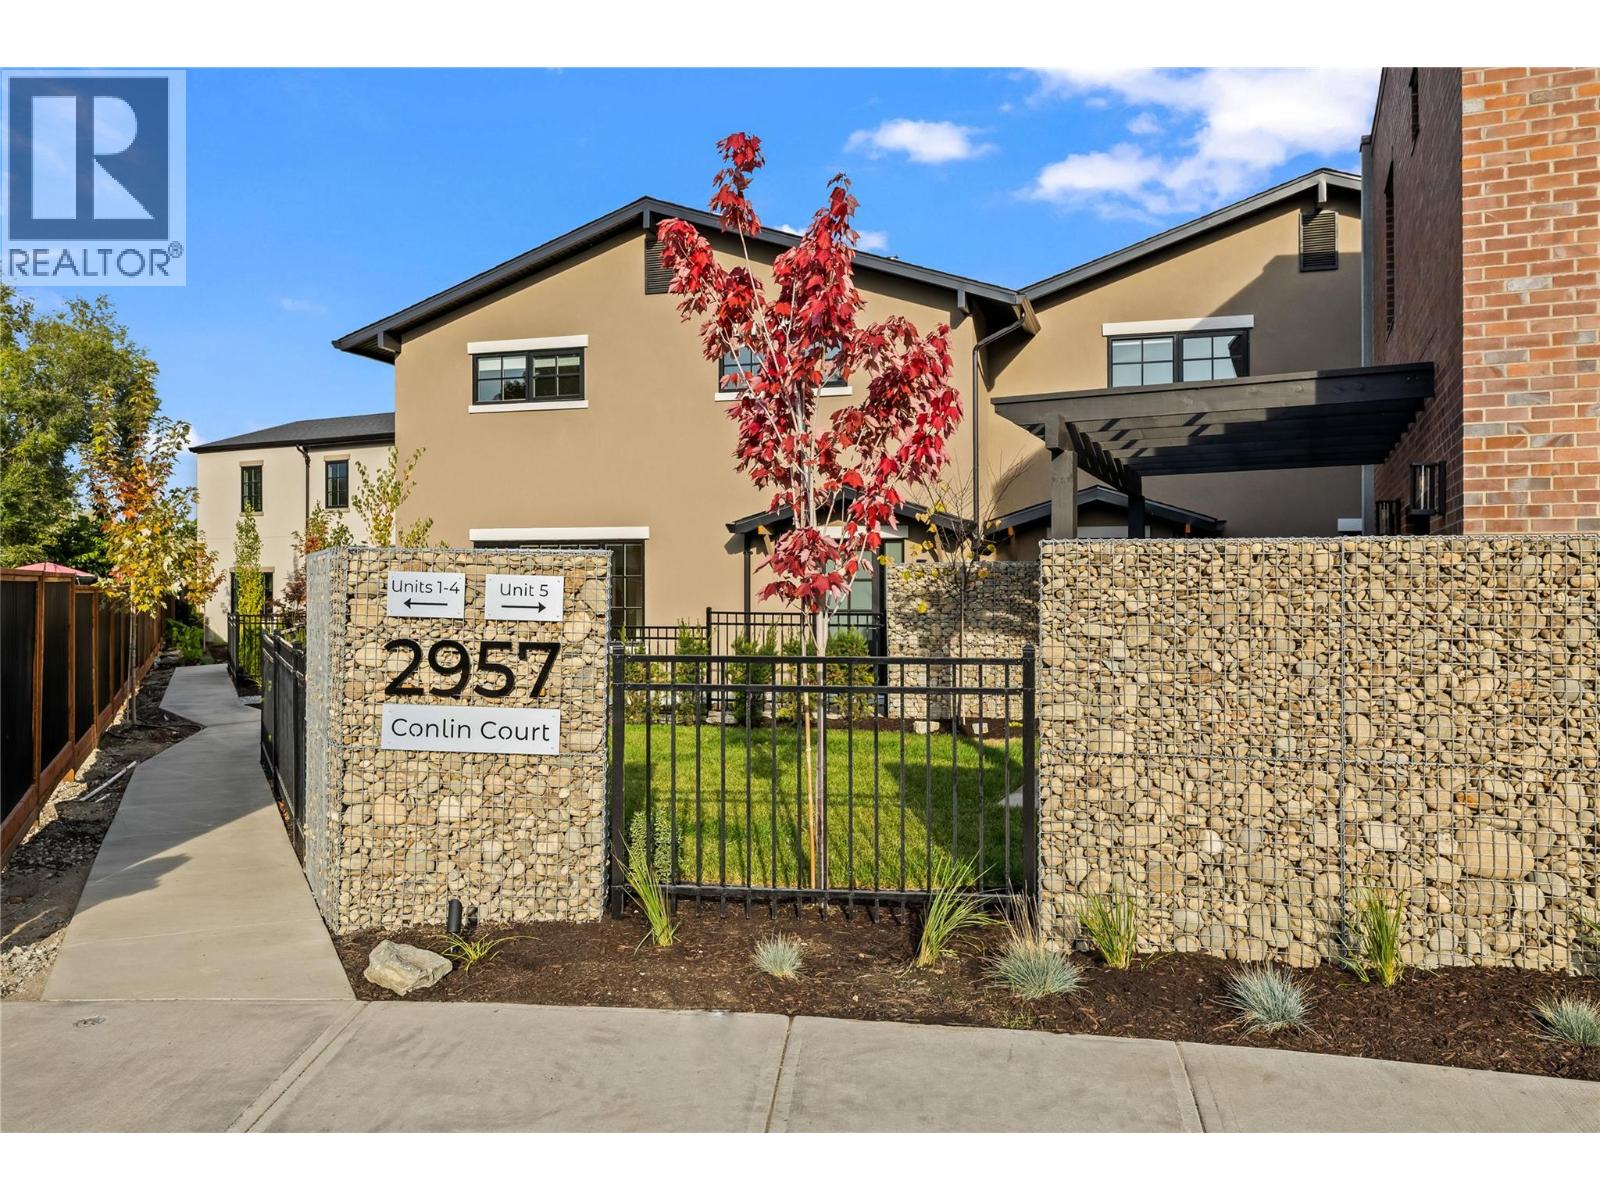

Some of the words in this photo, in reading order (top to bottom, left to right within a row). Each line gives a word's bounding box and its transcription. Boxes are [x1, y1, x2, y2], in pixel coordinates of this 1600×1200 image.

[391, 579, 433, 594] Units
[437, 581, 460, 595] 1-4
[500, 583, 535, 597] Unit
[539, 584, 549, 597] 5
[384, 638, 561, 699] 2957
[391, 718, 471, 739] Conlin
[480, 721, 550, 742] Court
